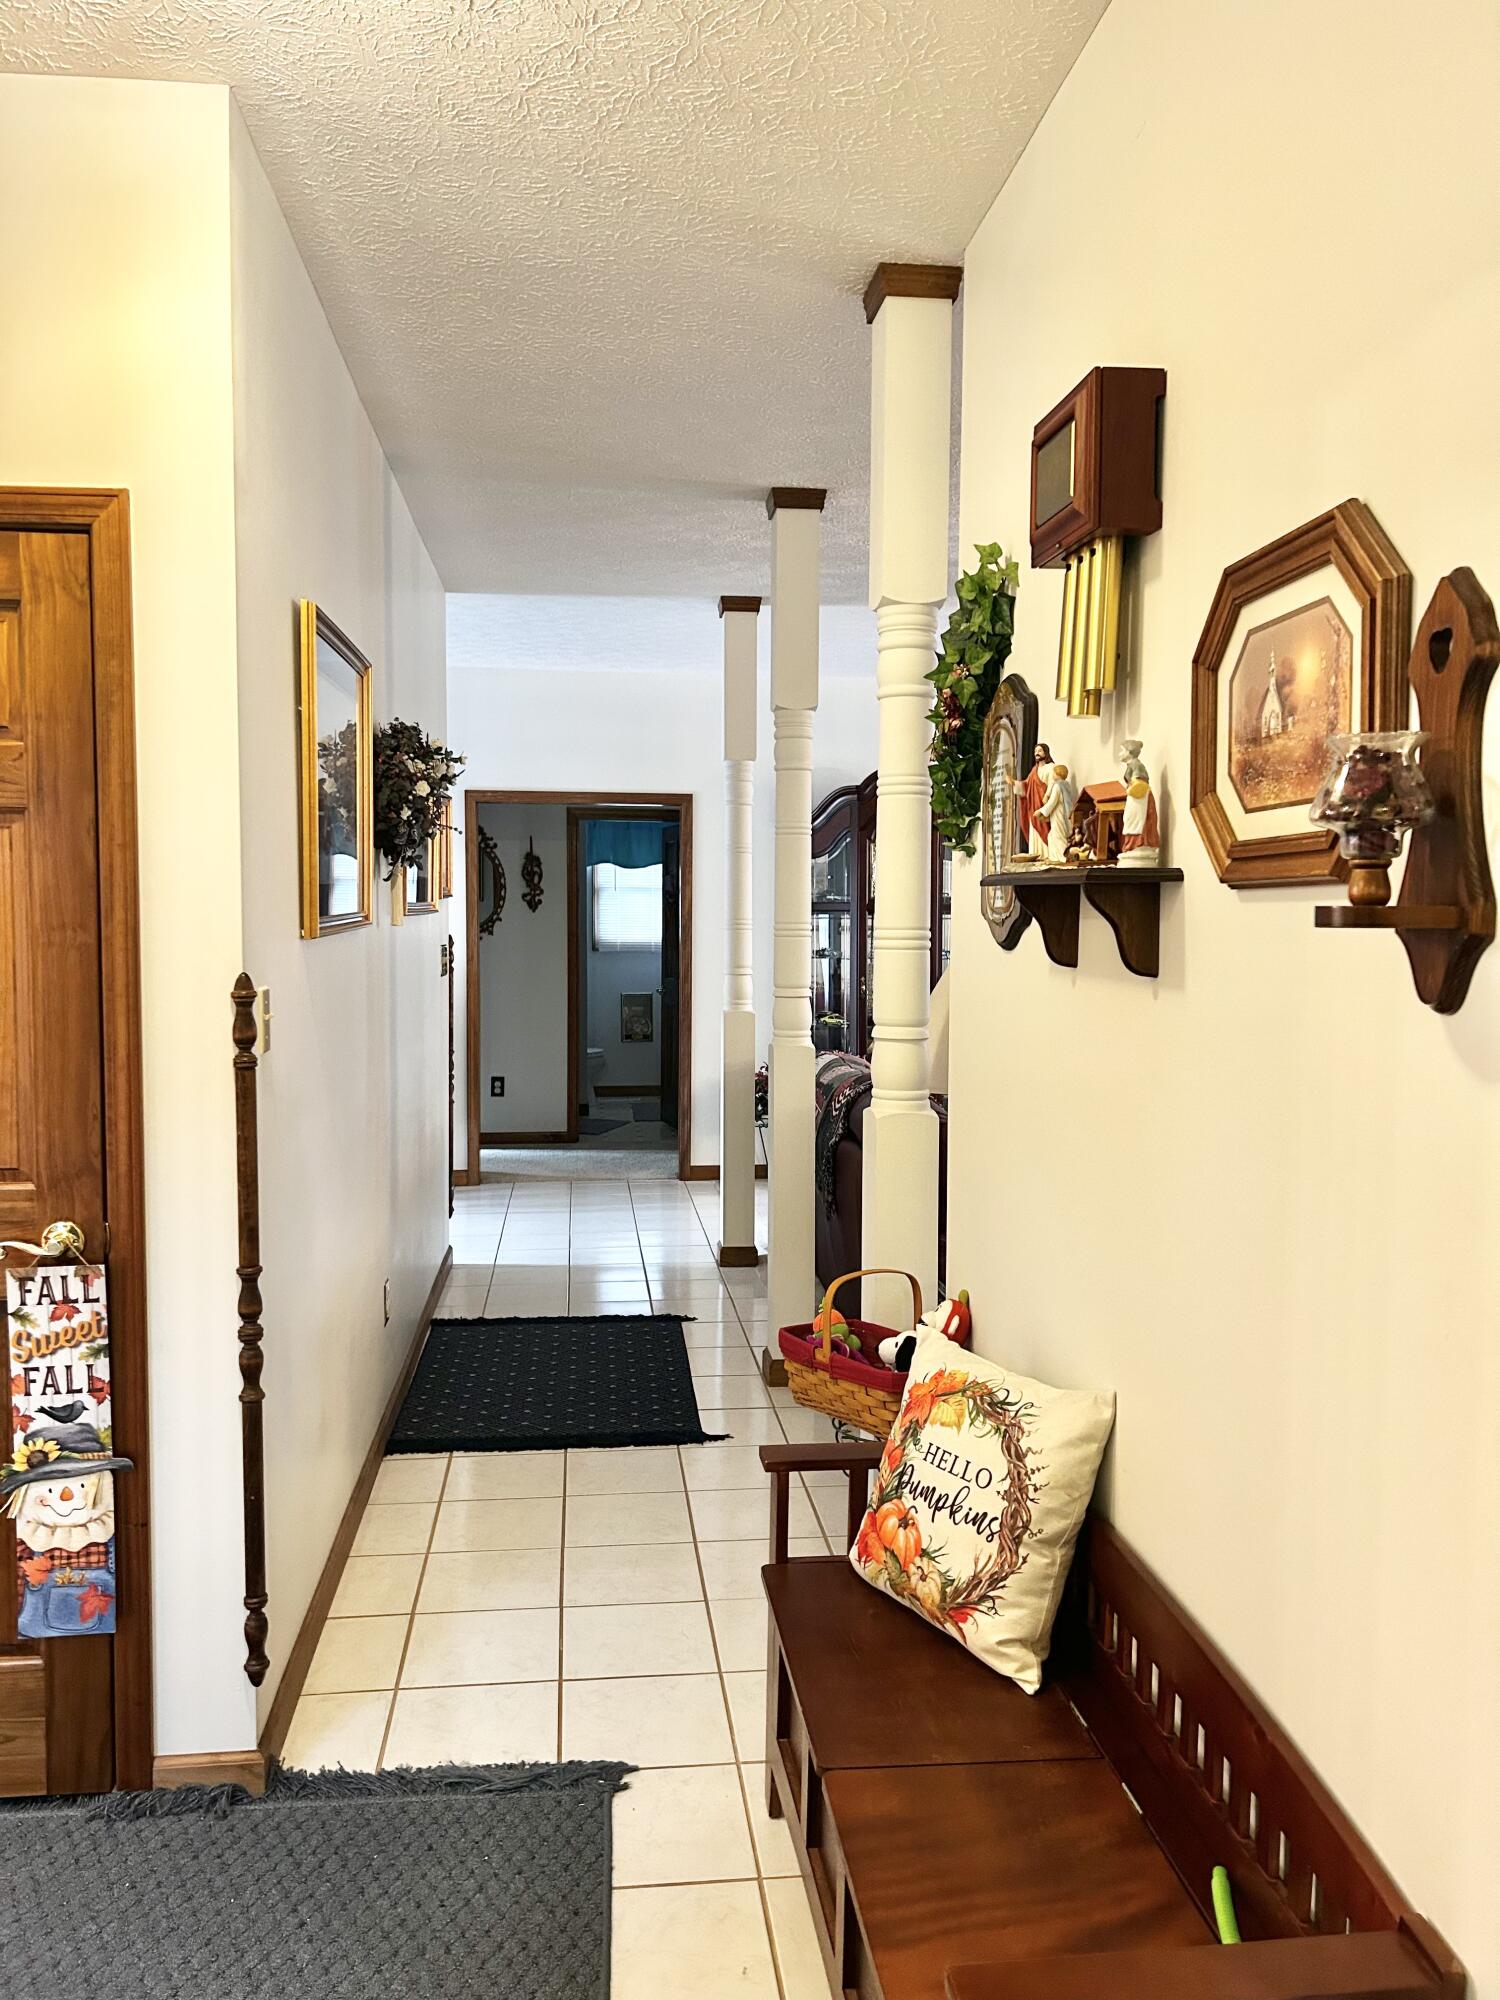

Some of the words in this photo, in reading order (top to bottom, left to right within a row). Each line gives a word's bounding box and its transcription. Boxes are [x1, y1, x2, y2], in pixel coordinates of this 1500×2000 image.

[18, 1275, 100, 1306] FALL
[12, 1311, 108, 1364] Sweet
[23, 1364, 104, 1396] FALL
[923, 1442, 992, 1489] HELLO
